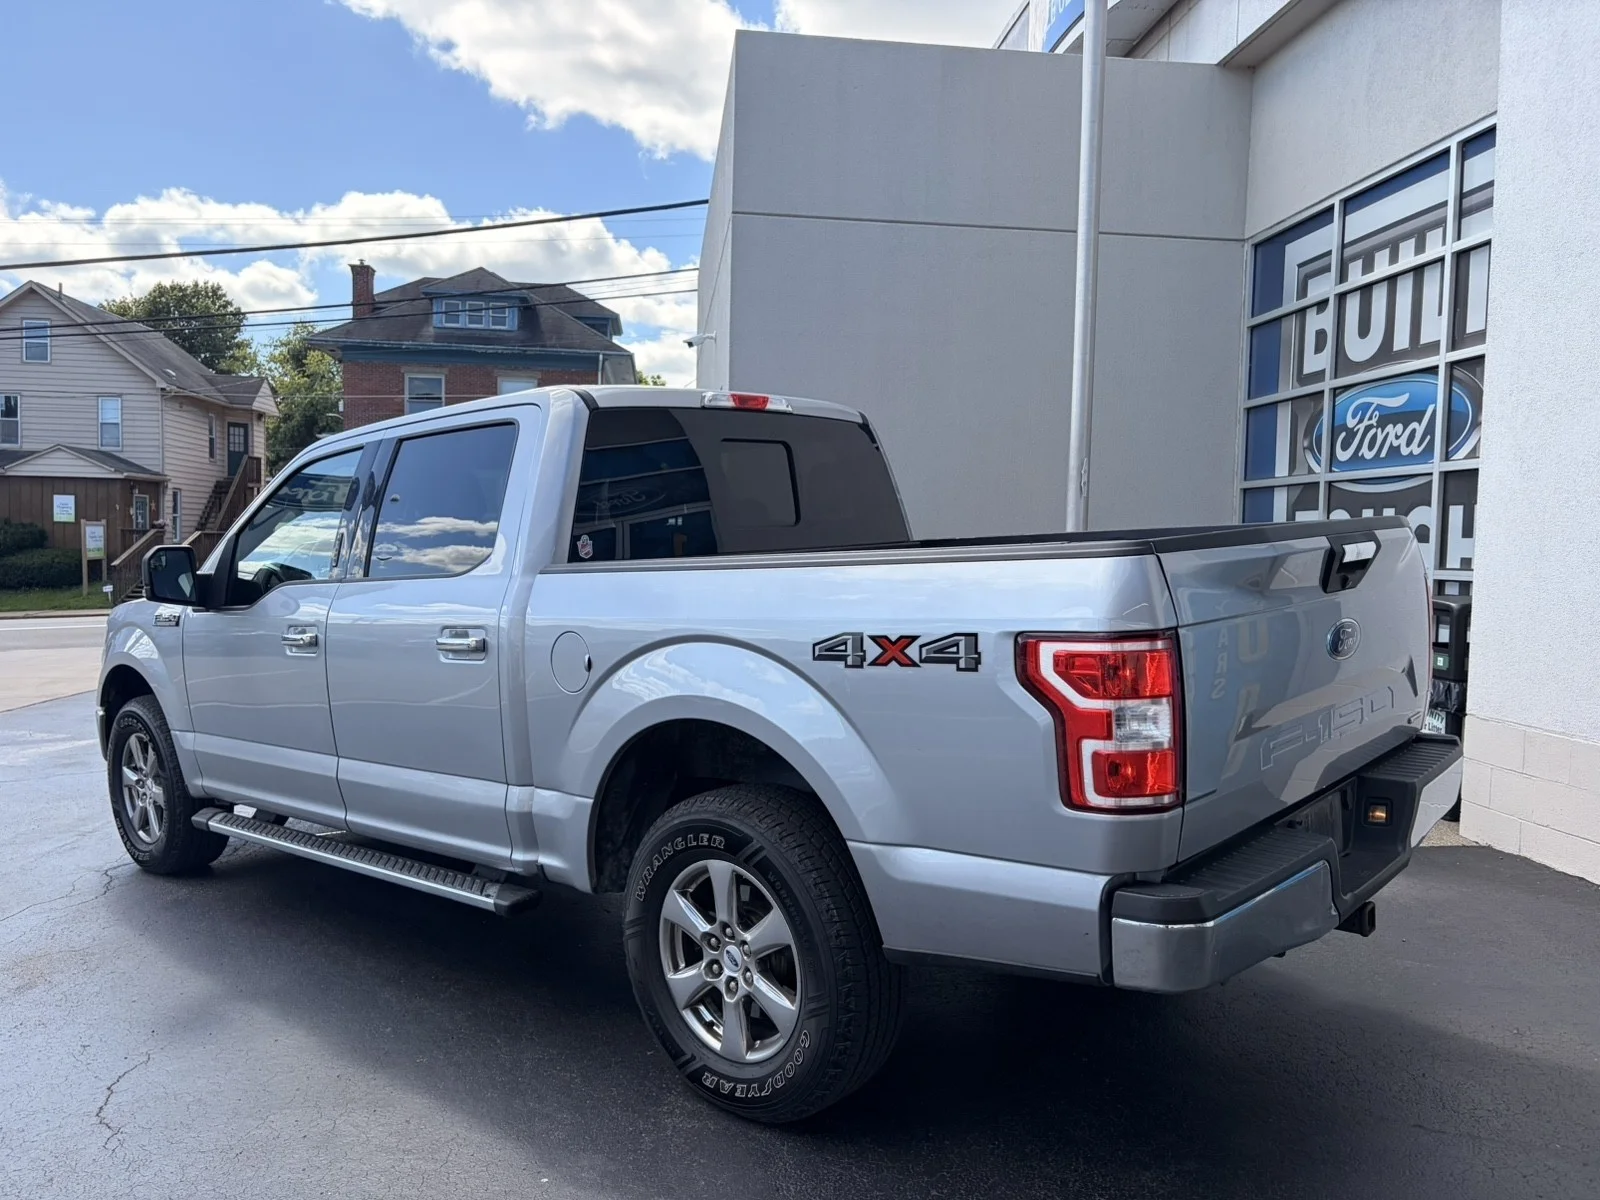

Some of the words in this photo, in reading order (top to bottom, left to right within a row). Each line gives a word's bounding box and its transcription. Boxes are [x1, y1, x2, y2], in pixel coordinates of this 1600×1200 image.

[1335, 392, 1435, 460] Ford
[1260, 686, 1394, 771] F-150
[1428, 710, 1445, 724] NITY
[635, 833, 725, 901] WRANGLER
[702, 1030, 811, 1098] GOODYEAR
